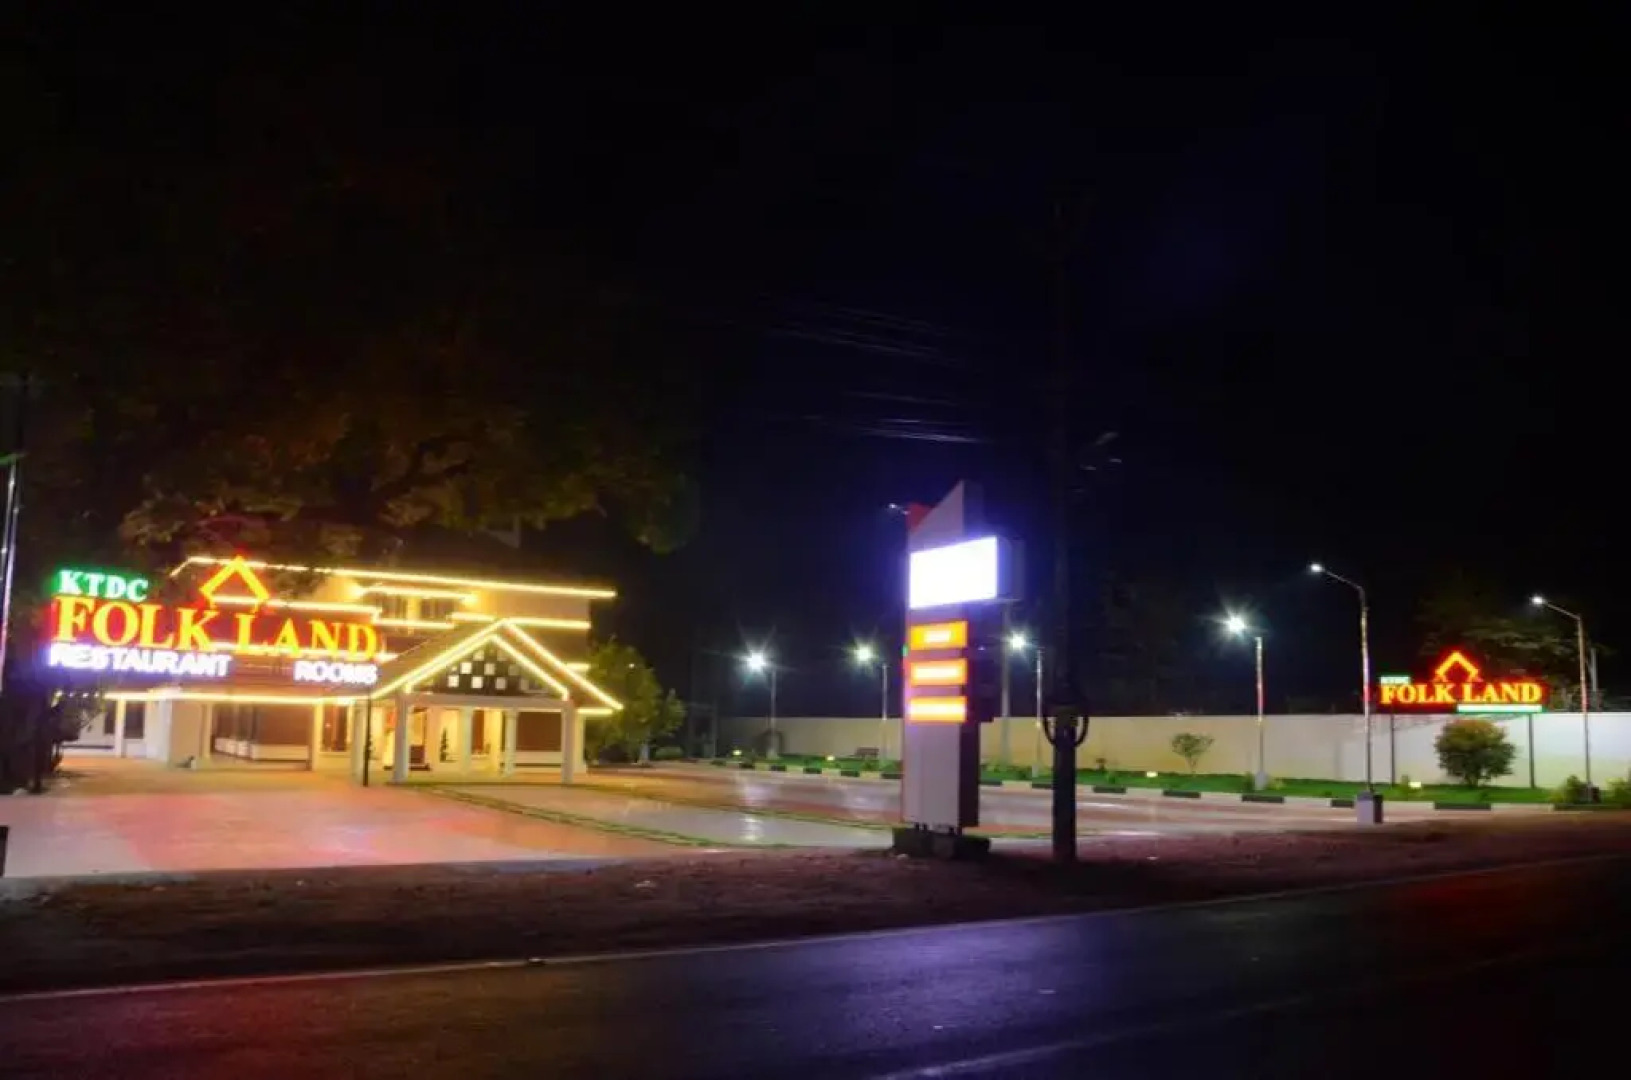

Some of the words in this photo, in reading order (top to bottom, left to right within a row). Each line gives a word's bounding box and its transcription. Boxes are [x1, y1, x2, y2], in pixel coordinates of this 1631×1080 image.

[58, 568, 149, 602] KTDC
[54, 595, 219, 652] FOLK
[234, 612, 379, 661] LAND
[48, 643, 232, 678] RESTAURANT
[294, 660, 378, 685] ROOMS
[1380, 683, 1455, 704] FOLK
[1463, 682, 1542, 703] LAND
